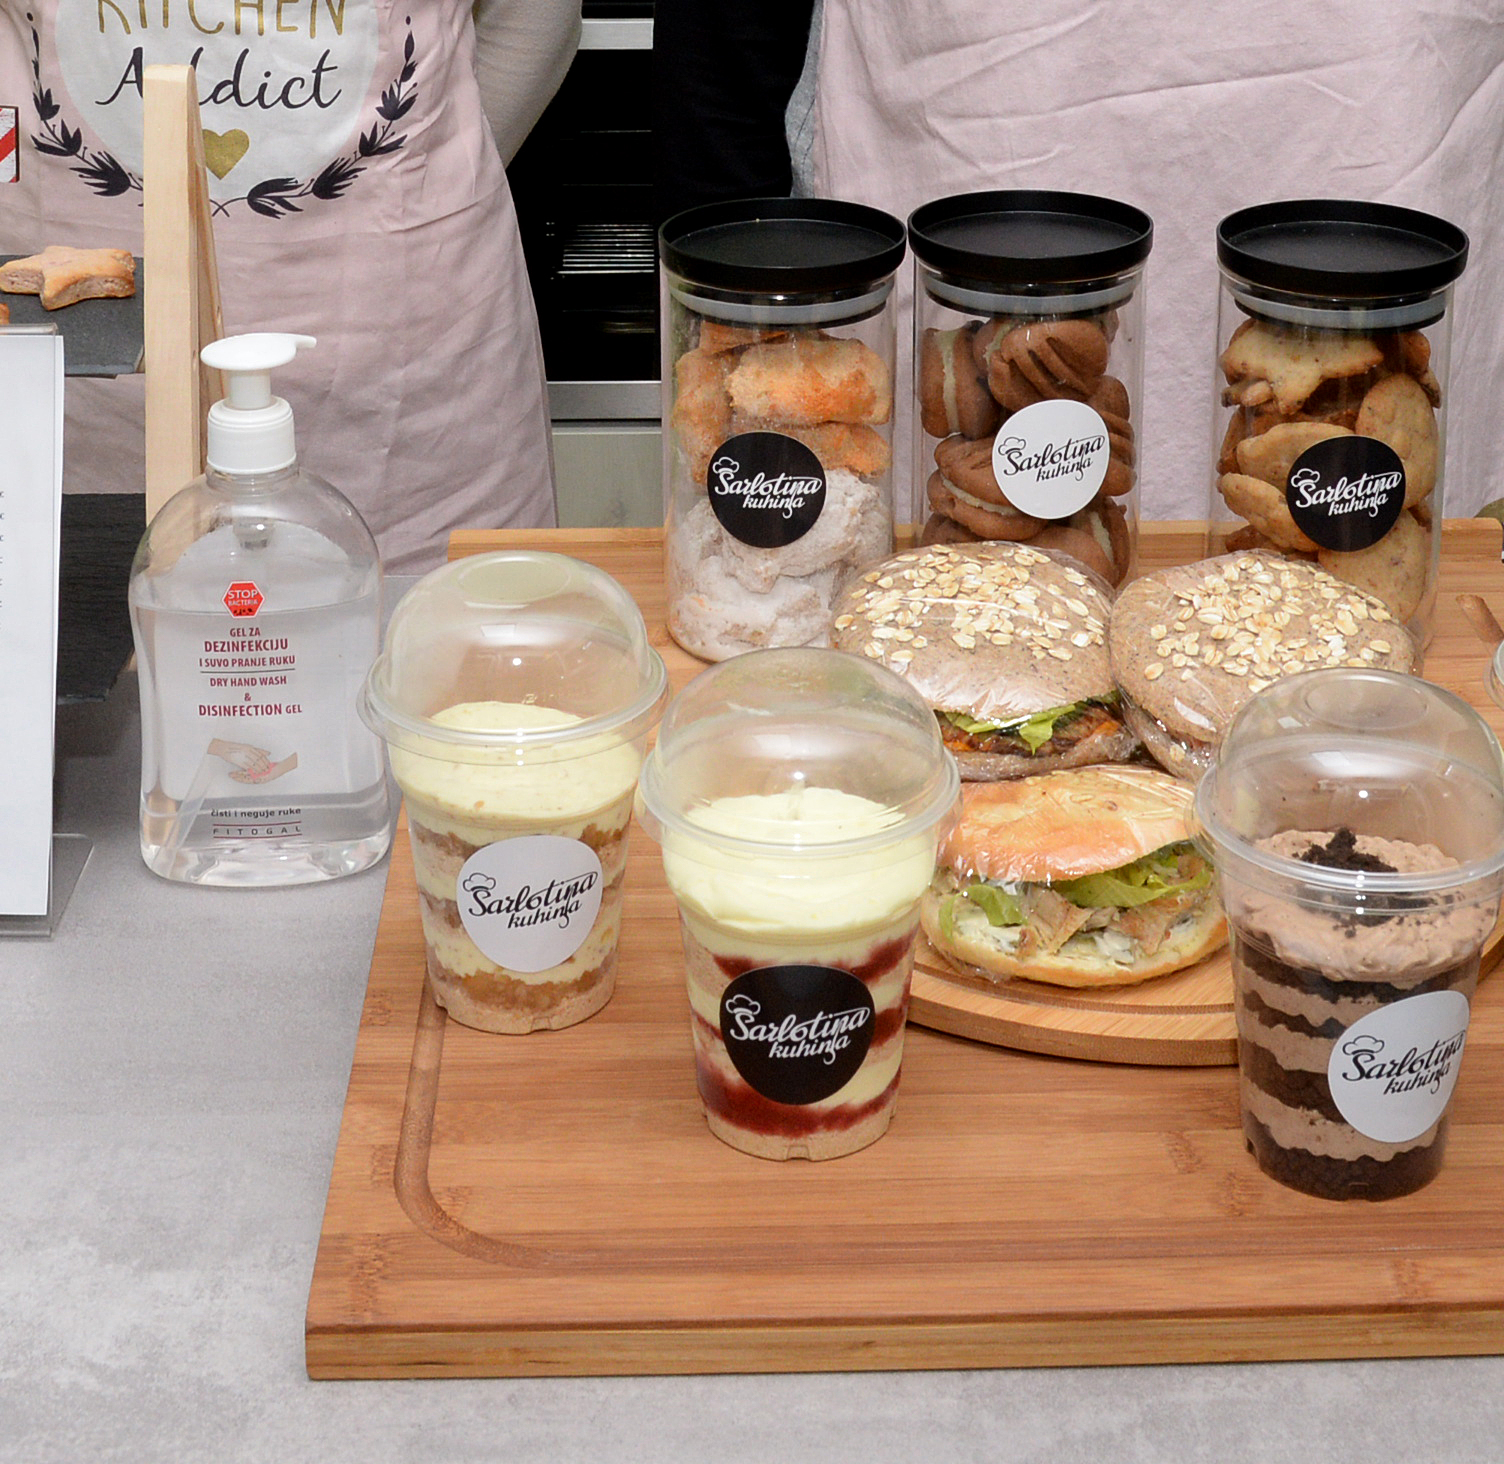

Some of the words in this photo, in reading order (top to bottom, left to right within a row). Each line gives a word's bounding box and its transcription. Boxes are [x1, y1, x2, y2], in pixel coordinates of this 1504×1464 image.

[228, 589, 259, 599] STOP
[229, 627, 247, 637] GEL
[248, 627, 261, 637] ZA
[204, 638, 288, 653] DEZINFEKCIJU
[205, 658, 229, 668] SUVO
[231, 657, 267, 667] PRANJE
[269, 655, 296, 666] RUKU
[210, 677, 228, 687] DRY
[230, 677, 257, 687] HAND
[259, 676, 287, 686] WASH
[244, 692, 251, 702] &
[198, 703, 282, 717] DISINFECTION
[285, 704, 303, 714] GEL
[211, 809, 231, 817] čisti
[240, 809, 275, 819] neguje
[278, 808, 301, 816] ruke
